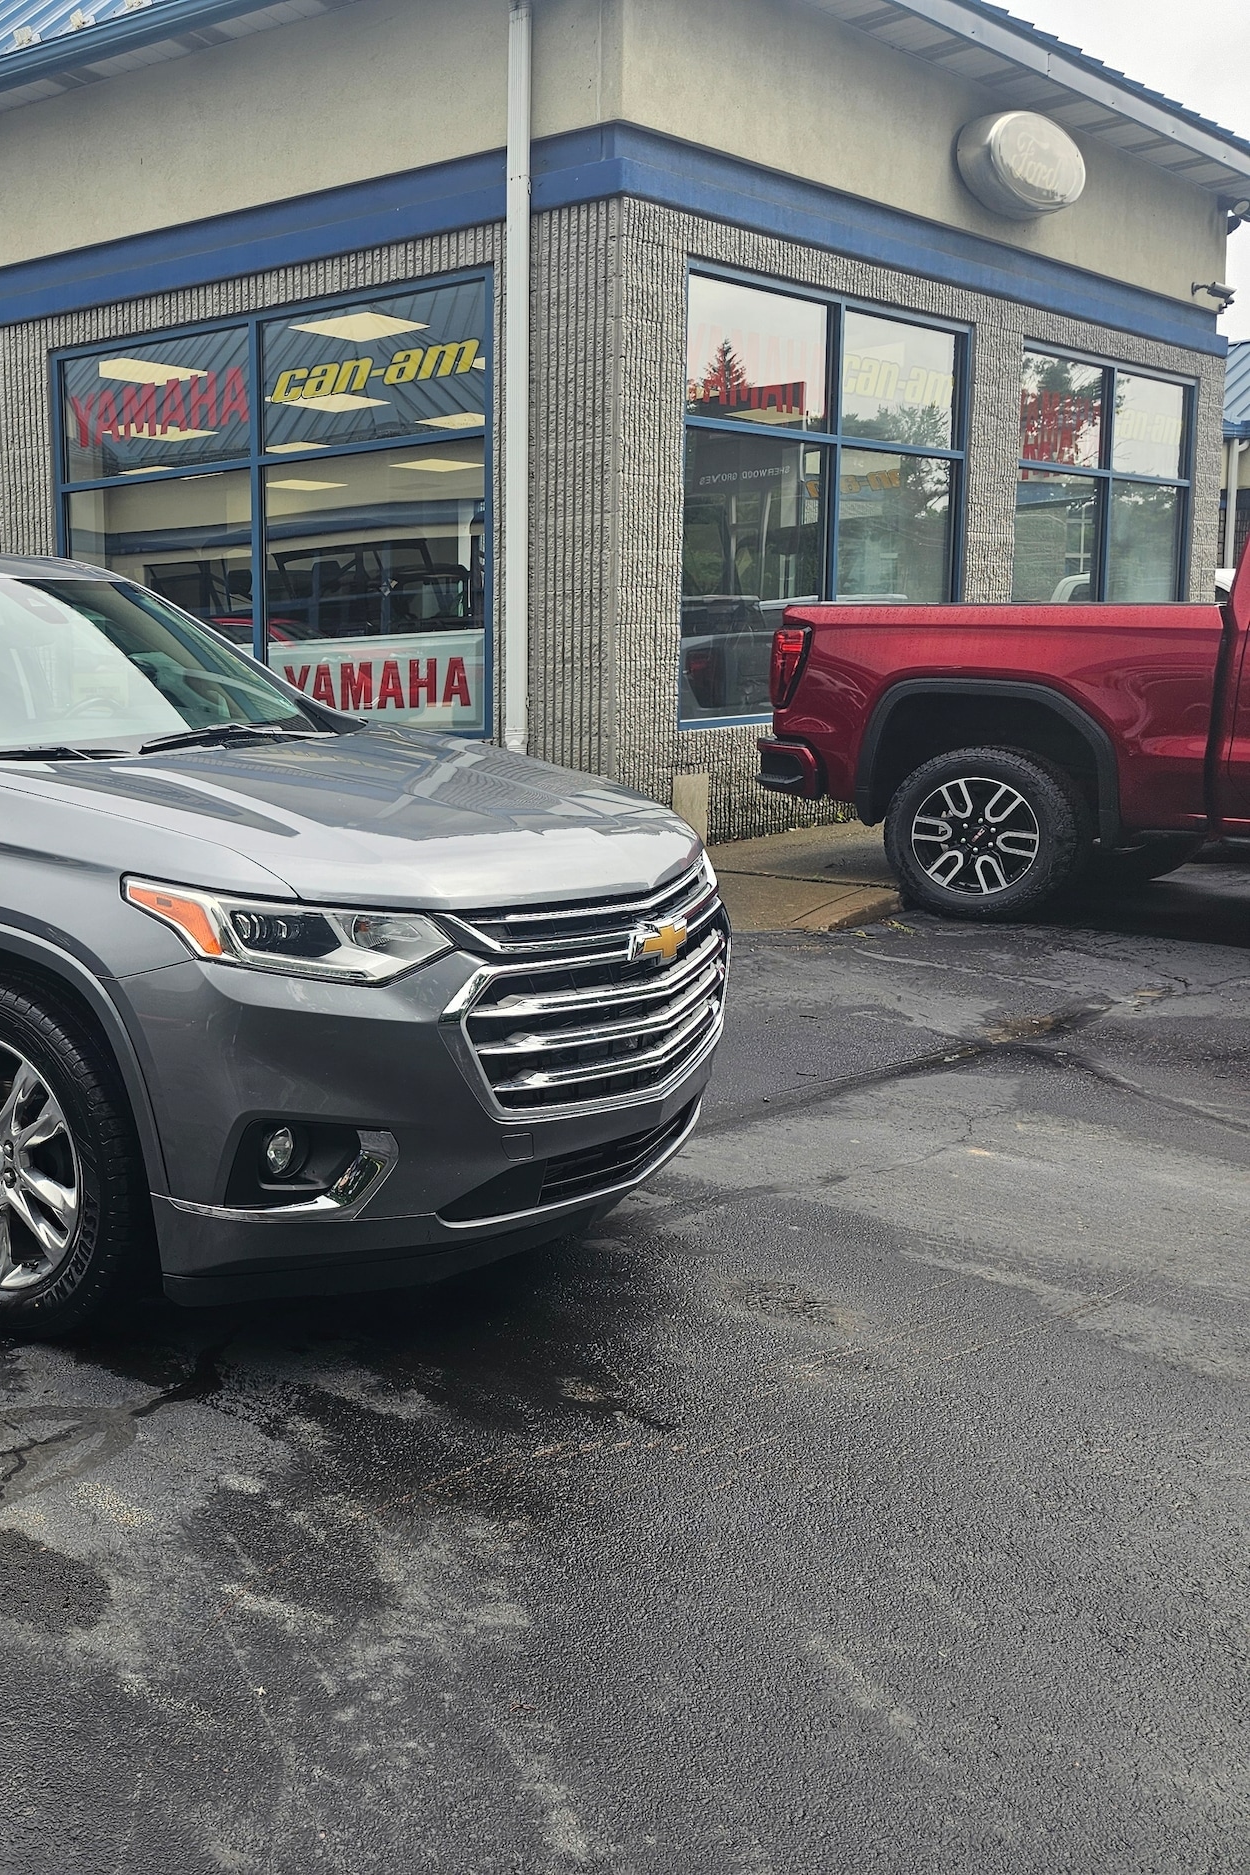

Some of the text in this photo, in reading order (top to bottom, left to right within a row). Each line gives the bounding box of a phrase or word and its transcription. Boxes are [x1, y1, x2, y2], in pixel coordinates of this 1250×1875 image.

[1010, 131, 1062, 190] Ford
[271, 339, 480, 403] can-am
[71, 367, 249, 448] YAMAHA
[284, 656, 471, 711] YAMAHA
